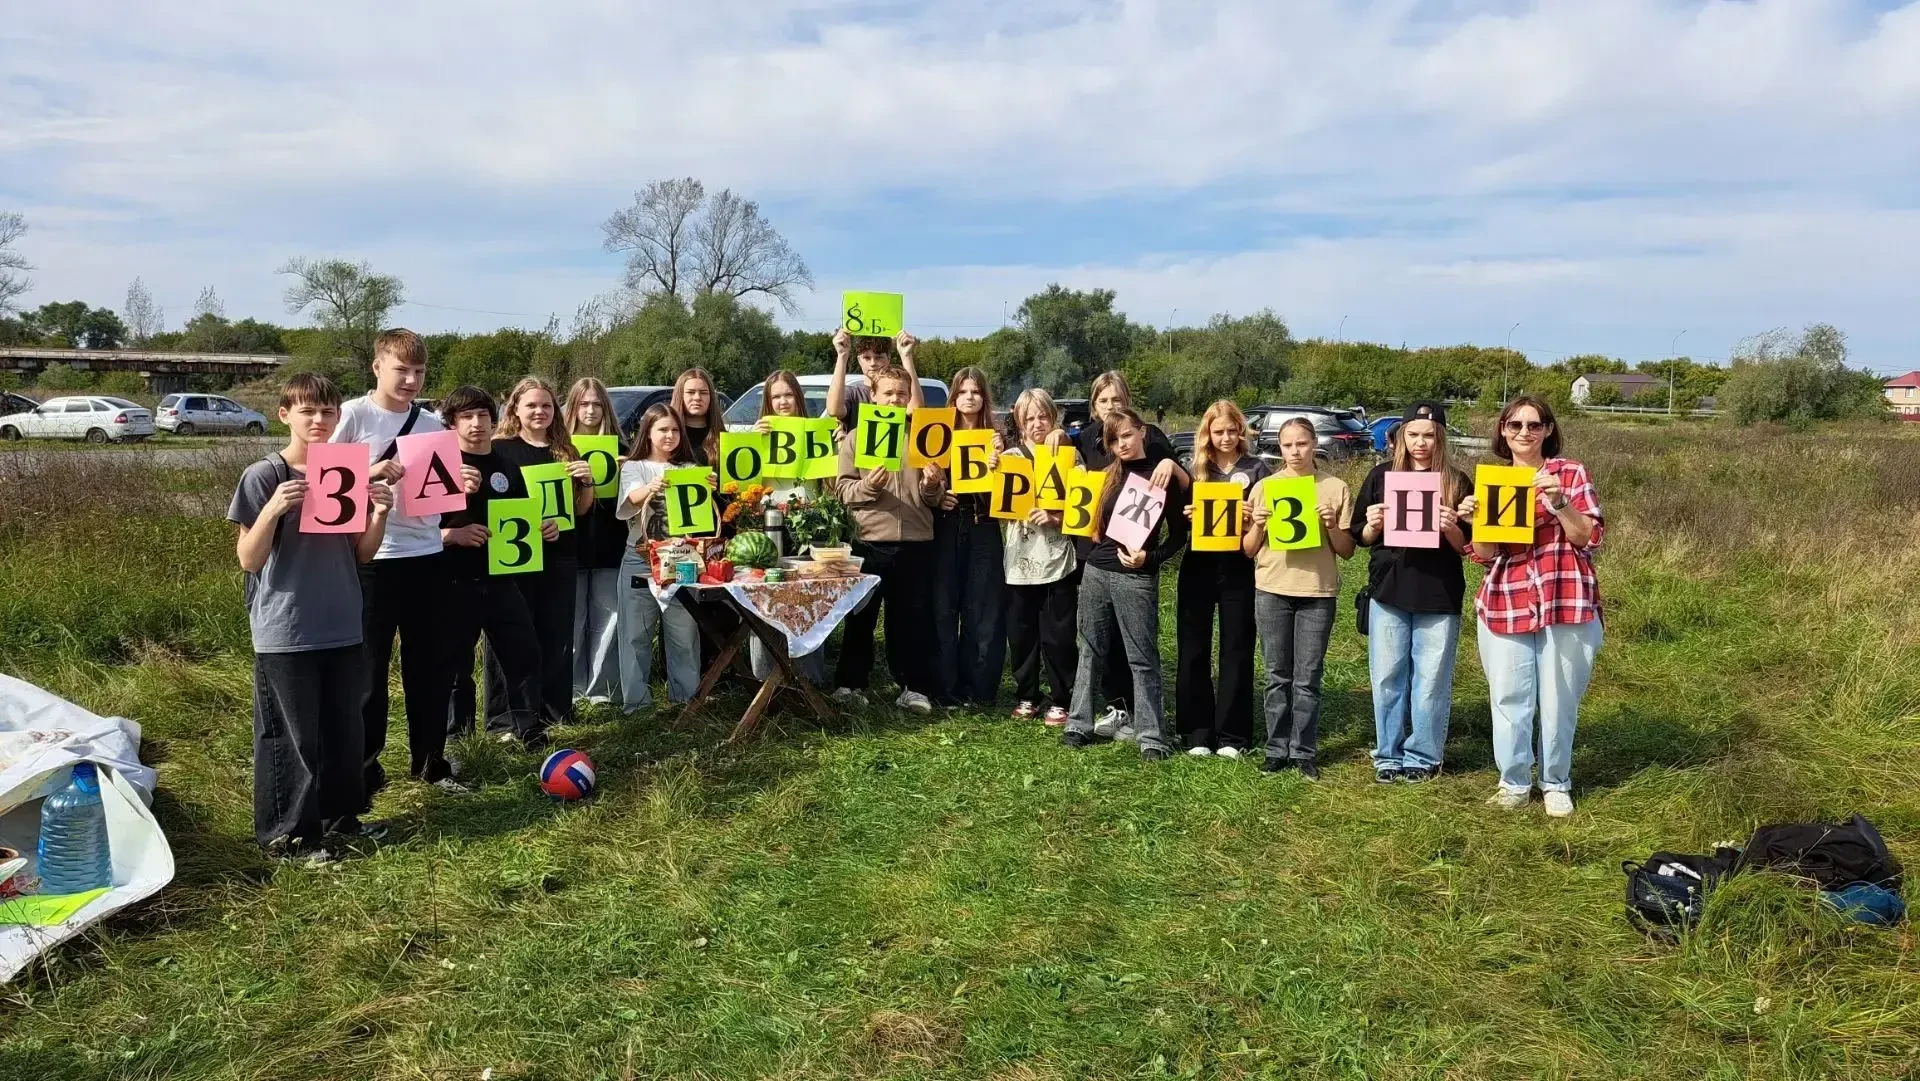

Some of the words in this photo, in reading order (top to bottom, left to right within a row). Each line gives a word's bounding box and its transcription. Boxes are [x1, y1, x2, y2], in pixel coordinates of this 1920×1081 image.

[846, 303, 863, 332] 8
[864, 410, 902, 459] Й
[415, 450, 464, 499] А
[959, 445, 988, 481] Б
[1036, 462, 1065, 501] А
[536, 478, 572, 526] Д
[673, 483, 708, 528] Р
[996, 472, 1031, 513] Р
[1117, 487, 1163, 530] Ж
[1391, 489, 1440, 532] Н
[1481, 485, 1535, 528] И
[1200, 499, 1238, 538] И
